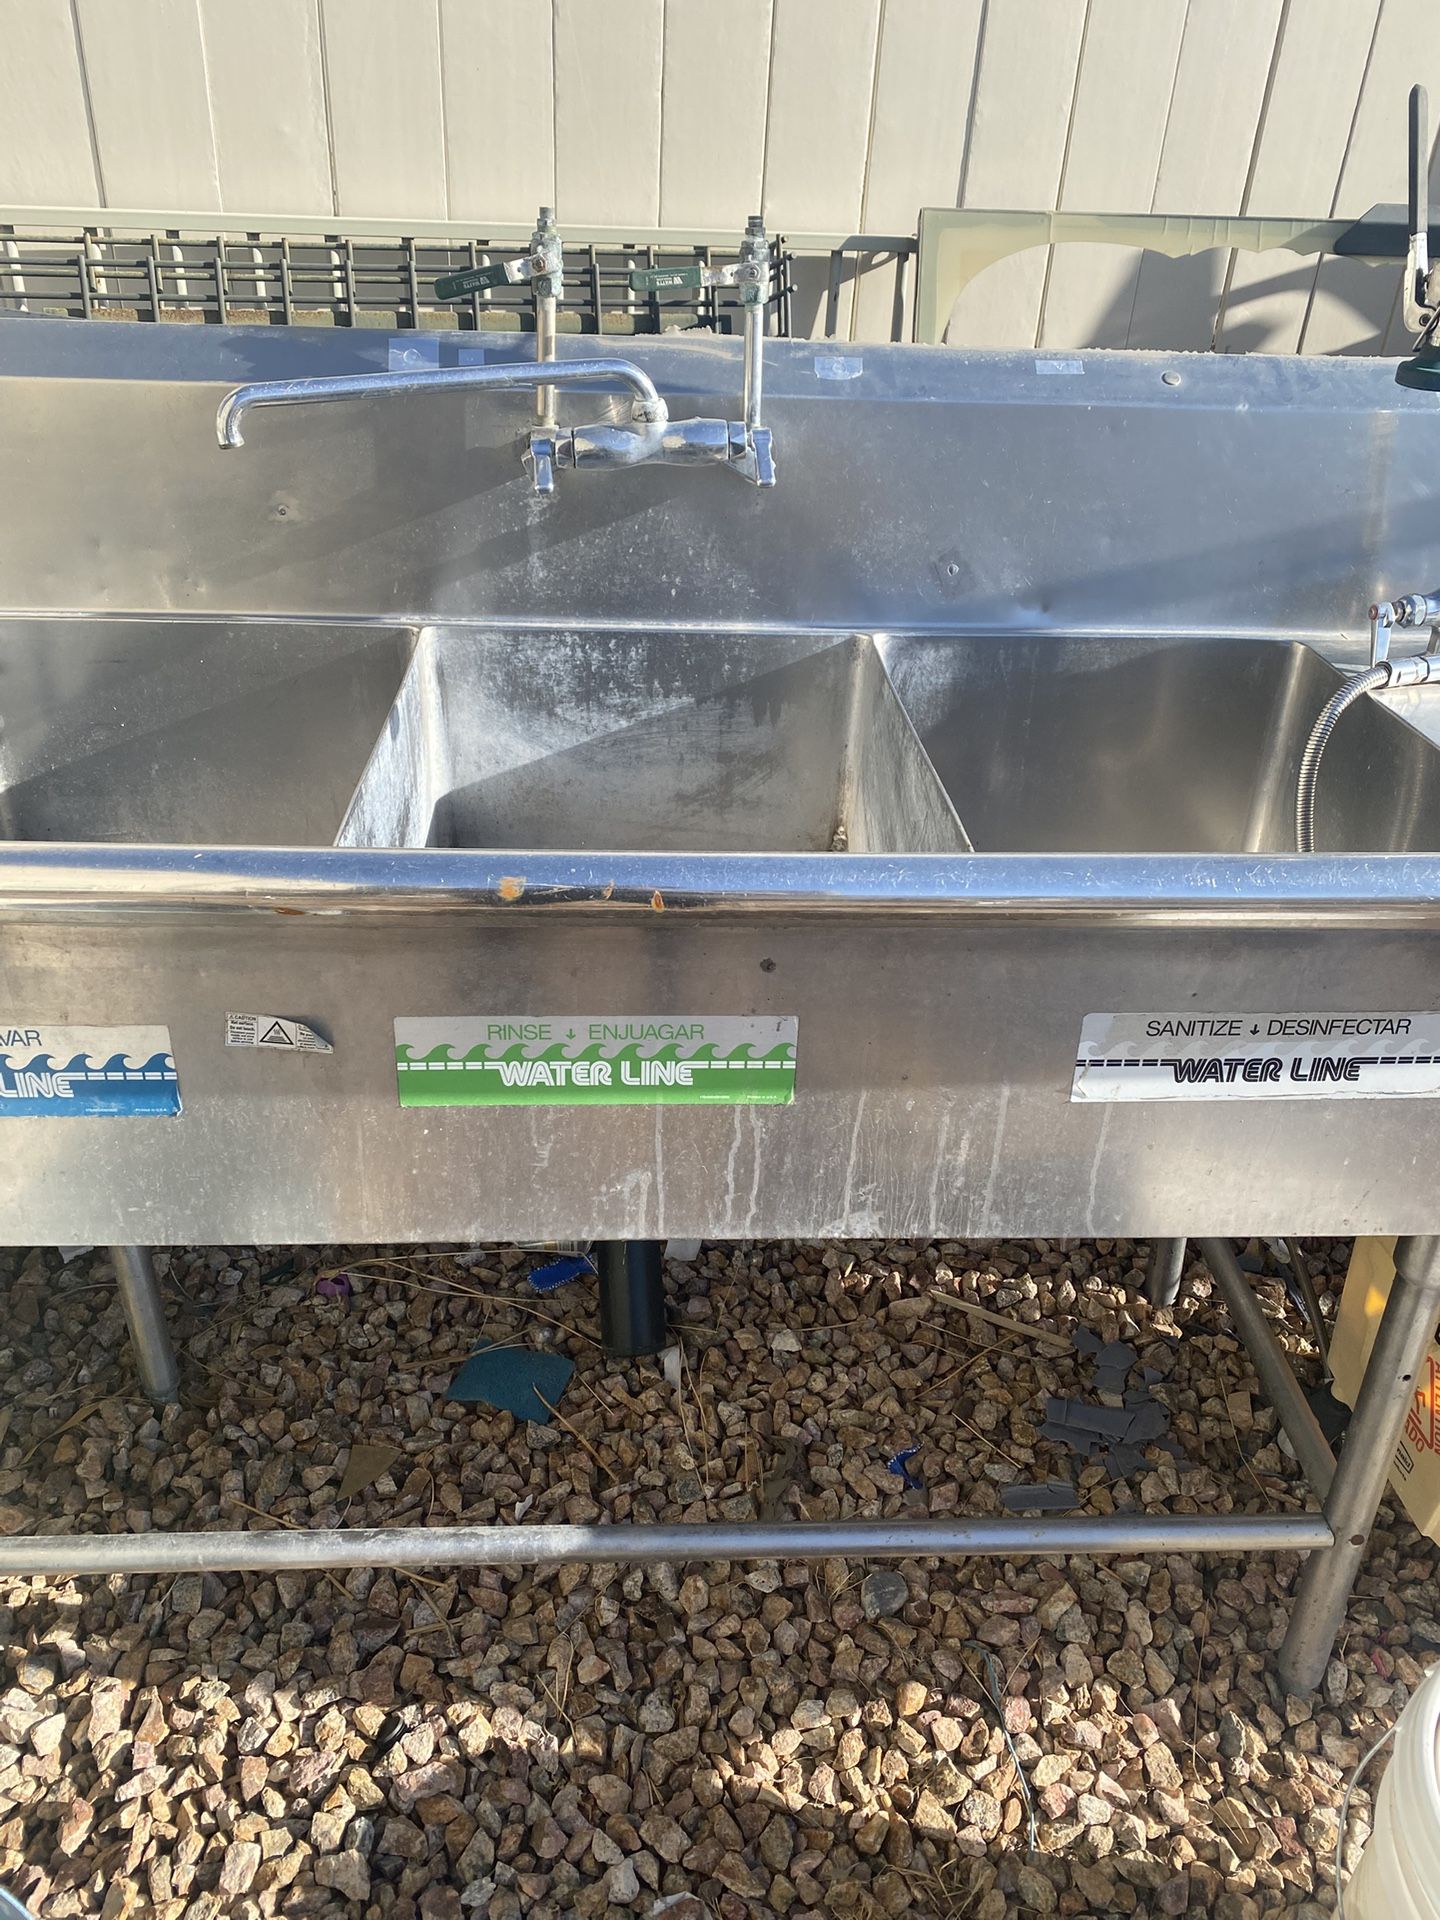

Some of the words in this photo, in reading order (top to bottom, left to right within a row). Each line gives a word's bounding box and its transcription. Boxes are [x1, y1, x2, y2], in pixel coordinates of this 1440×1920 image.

[487, 1023, 552, 1041] RINSE
[588, 1022, 705, 1041] ENJUAGAR
[1145, 1019, 1243, 1037] SANITIZE
[1267, 1018, 1412, 1036] DESINFECTAR
[499, 1060, 613, 1087] WATER
[620, 1060, 696, 1086] LINE
[1172, 1057, 1283, 1083] WATER
[1290, 1056, 1363, 1082] LINE
